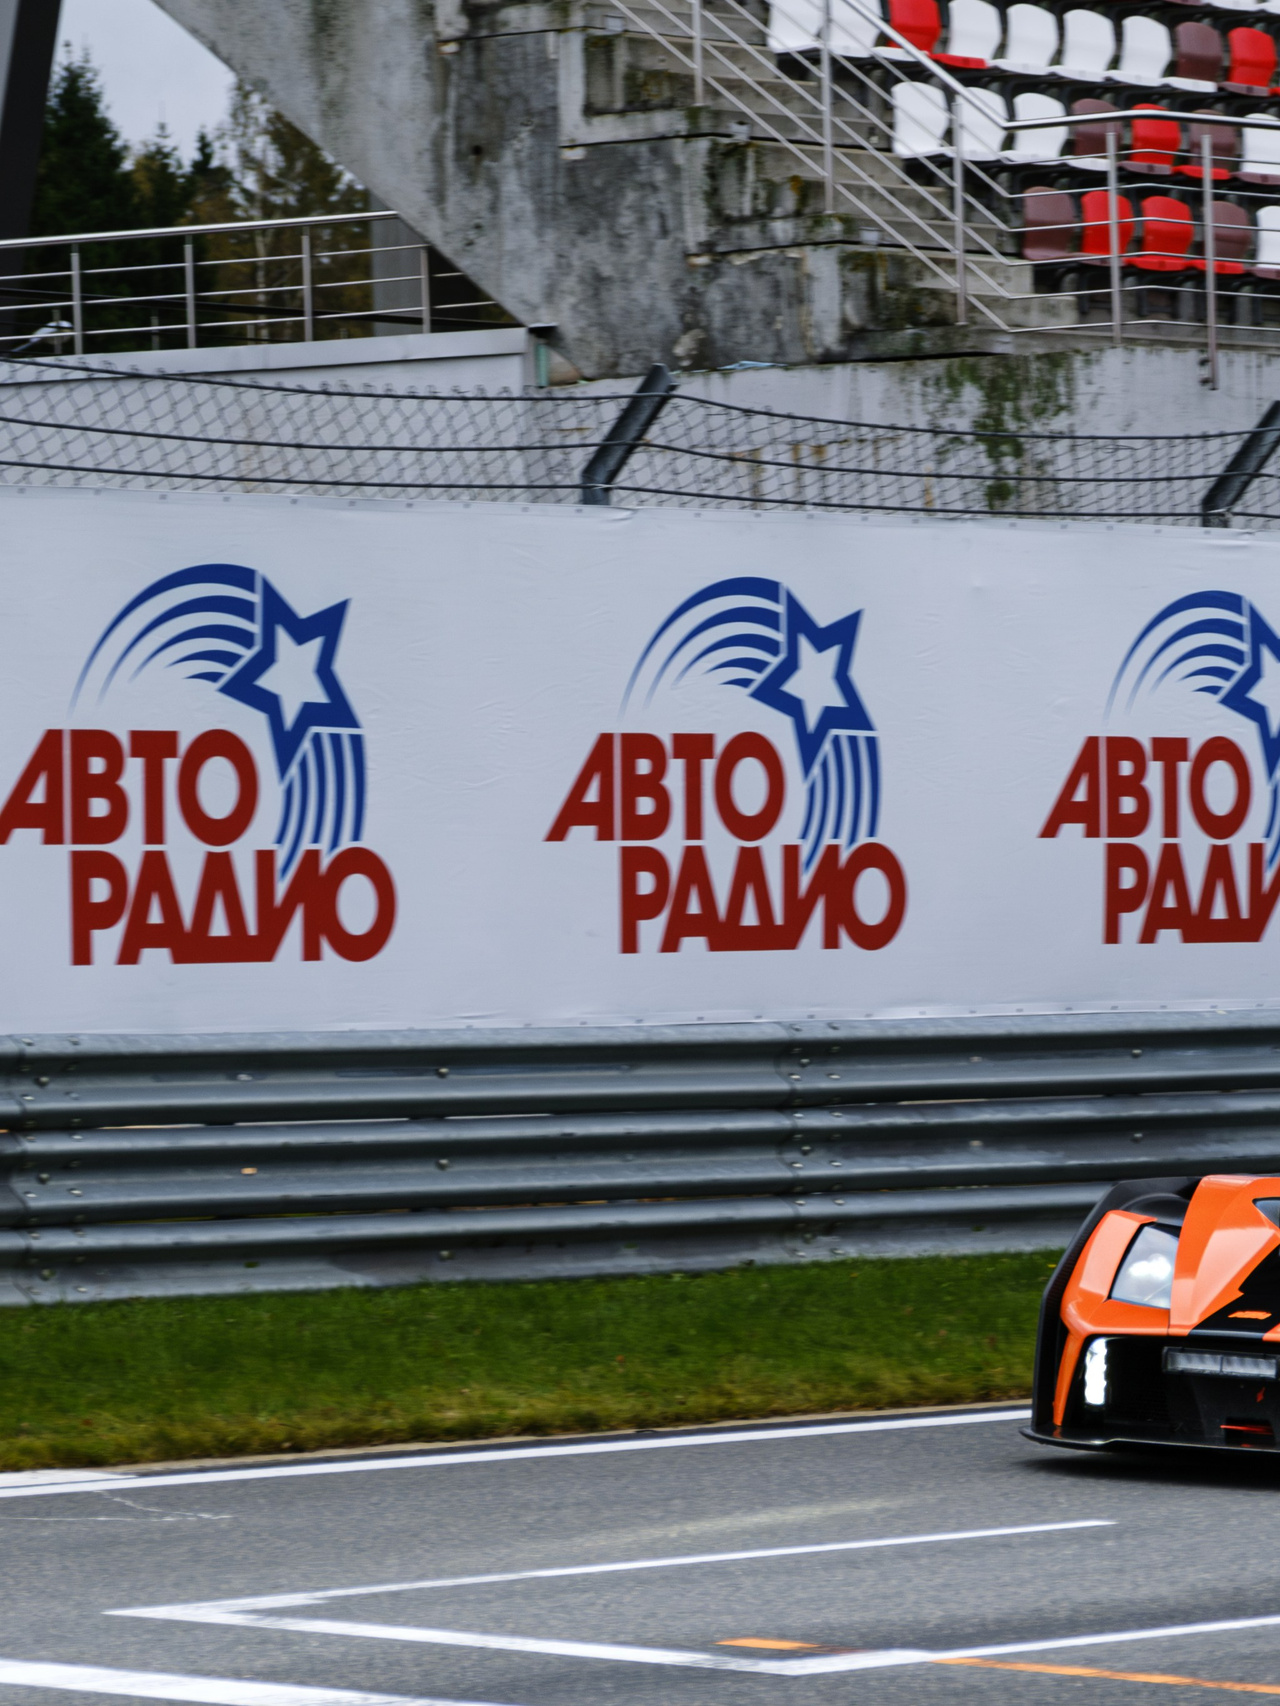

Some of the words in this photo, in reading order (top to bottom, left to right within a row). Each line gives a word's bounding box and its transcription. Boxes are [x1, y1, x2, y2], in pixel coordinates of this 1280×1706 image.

[0, 729, 259, 847] АВТО
[546, 731, 785, 842] АВТО
[1039, 736, 1251, 840] АВТО
[70, 847, 396, 966] РАДИО
[620, 842, 907, 954] РАДИО
